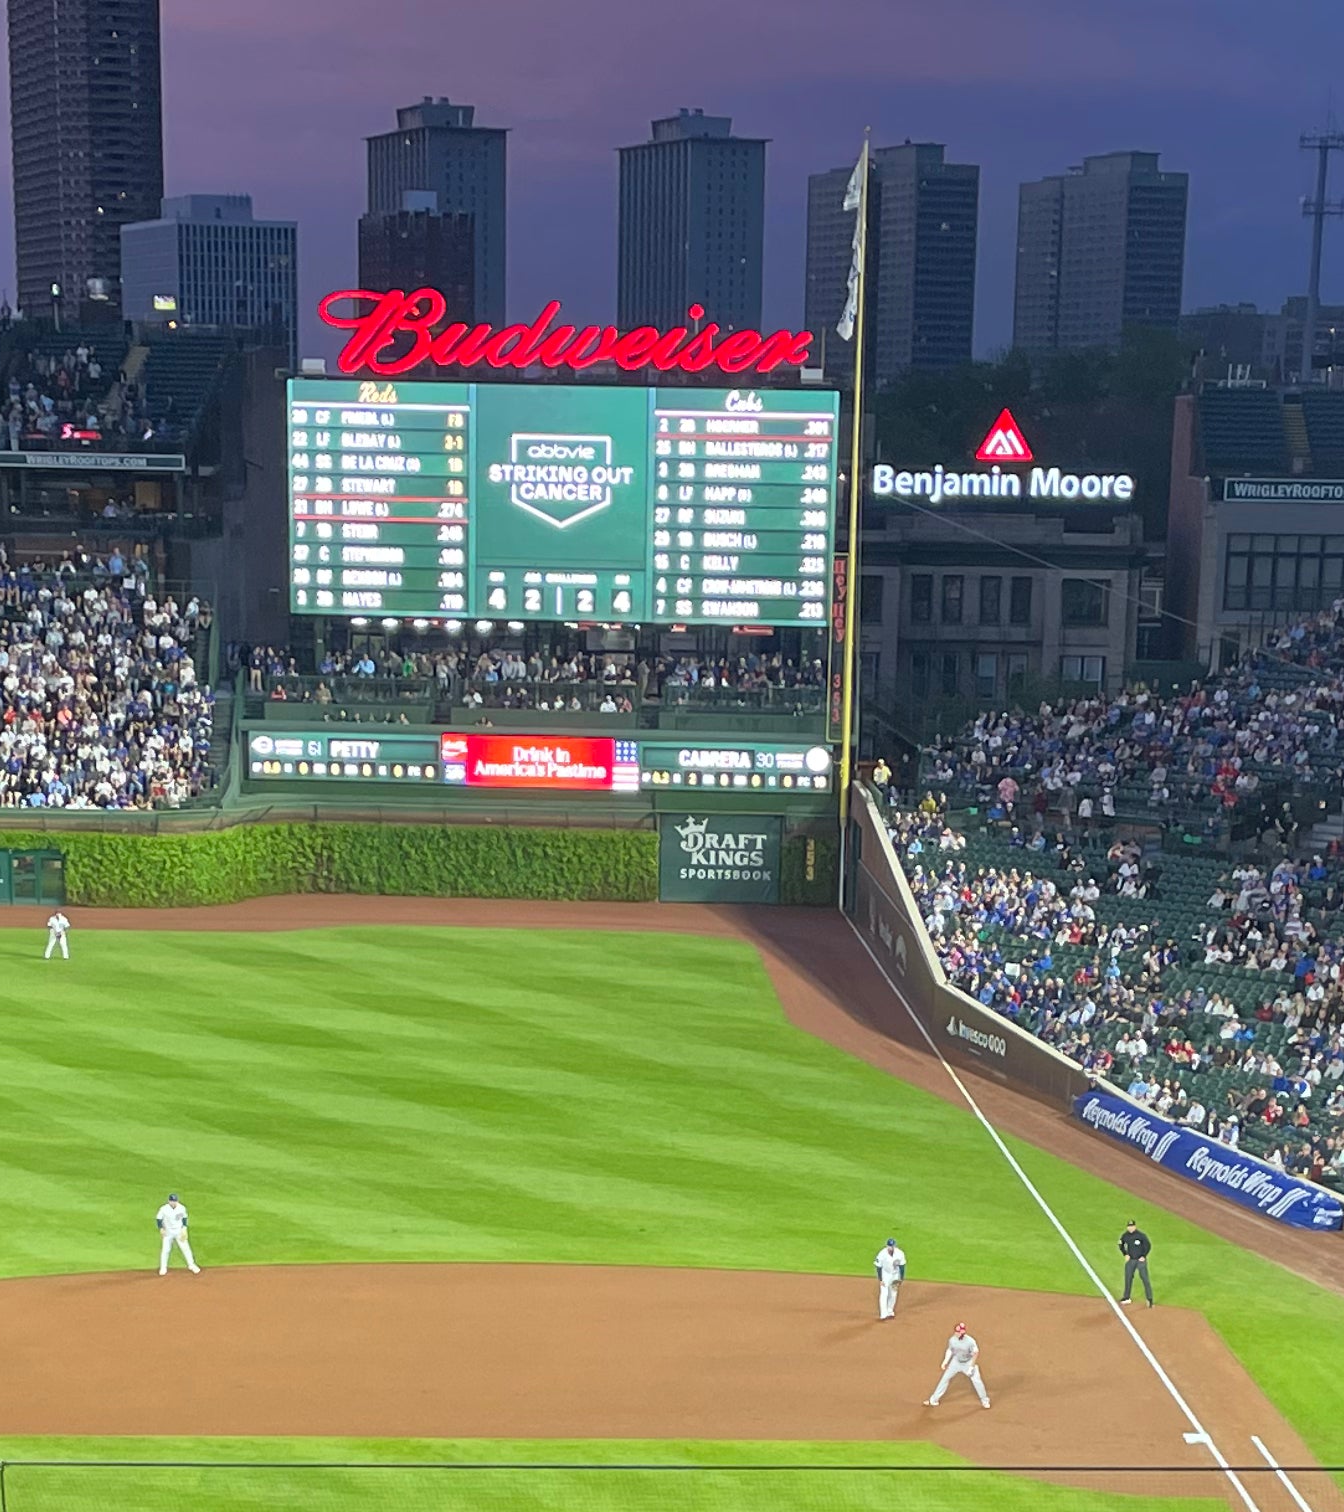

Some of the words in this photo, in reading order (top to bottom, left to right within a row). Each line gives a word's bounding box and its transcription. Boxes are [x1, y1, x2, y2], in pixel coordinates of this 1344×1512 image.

[318, 287, 814, 375] Budweiser
[358, 381, 398, 403] Reds
[725, 390, 763, 411] Cubs
[527, 444, 595, 459] abbvie
[358, 456, 375, 470] LA
[488, 464, 589, 482] STRIKING
[591, 466, 634, 485] OUT
[873, 464, 1020, 503] Benjamin
[1029, 467, 1135, 498] Moore
[520, 483, 602, 500] CANCER
[680, 554, 690, 570] C
[703, 555, 739, 571] KELLY
[488, 588, 506, 610] 4
[524, 588, 541, 611] 2
[577, 589, 594, 612] 2
[613, 590, 631, 613] 4
[330, 740, 380, 759] PETTY
[513, 746, 554, 763] Drink
[678, 749, 751, 768] CABRERA
[756, 752, 774, 768] 30
[474, 760, 545, 777] America's
[547, 763, 607, 779] Pastime
[680, 832, 767, 852] DRAFT
[690, 849, 764, 866] KINGS
[680, 868, 772, 881] SPORTSBOOK
[959, 1020, 988, 1048] Invesco
[989, 1034, 1006, 1057] QQQ
[1083, 1098, 1132, 1136] Reynolds
[1126, 1117, 1159, 1152] Wrap
[1186, 1147, 1248, 1189] Reynolds
[1241, 1170, 1283, 1207] Wrap
